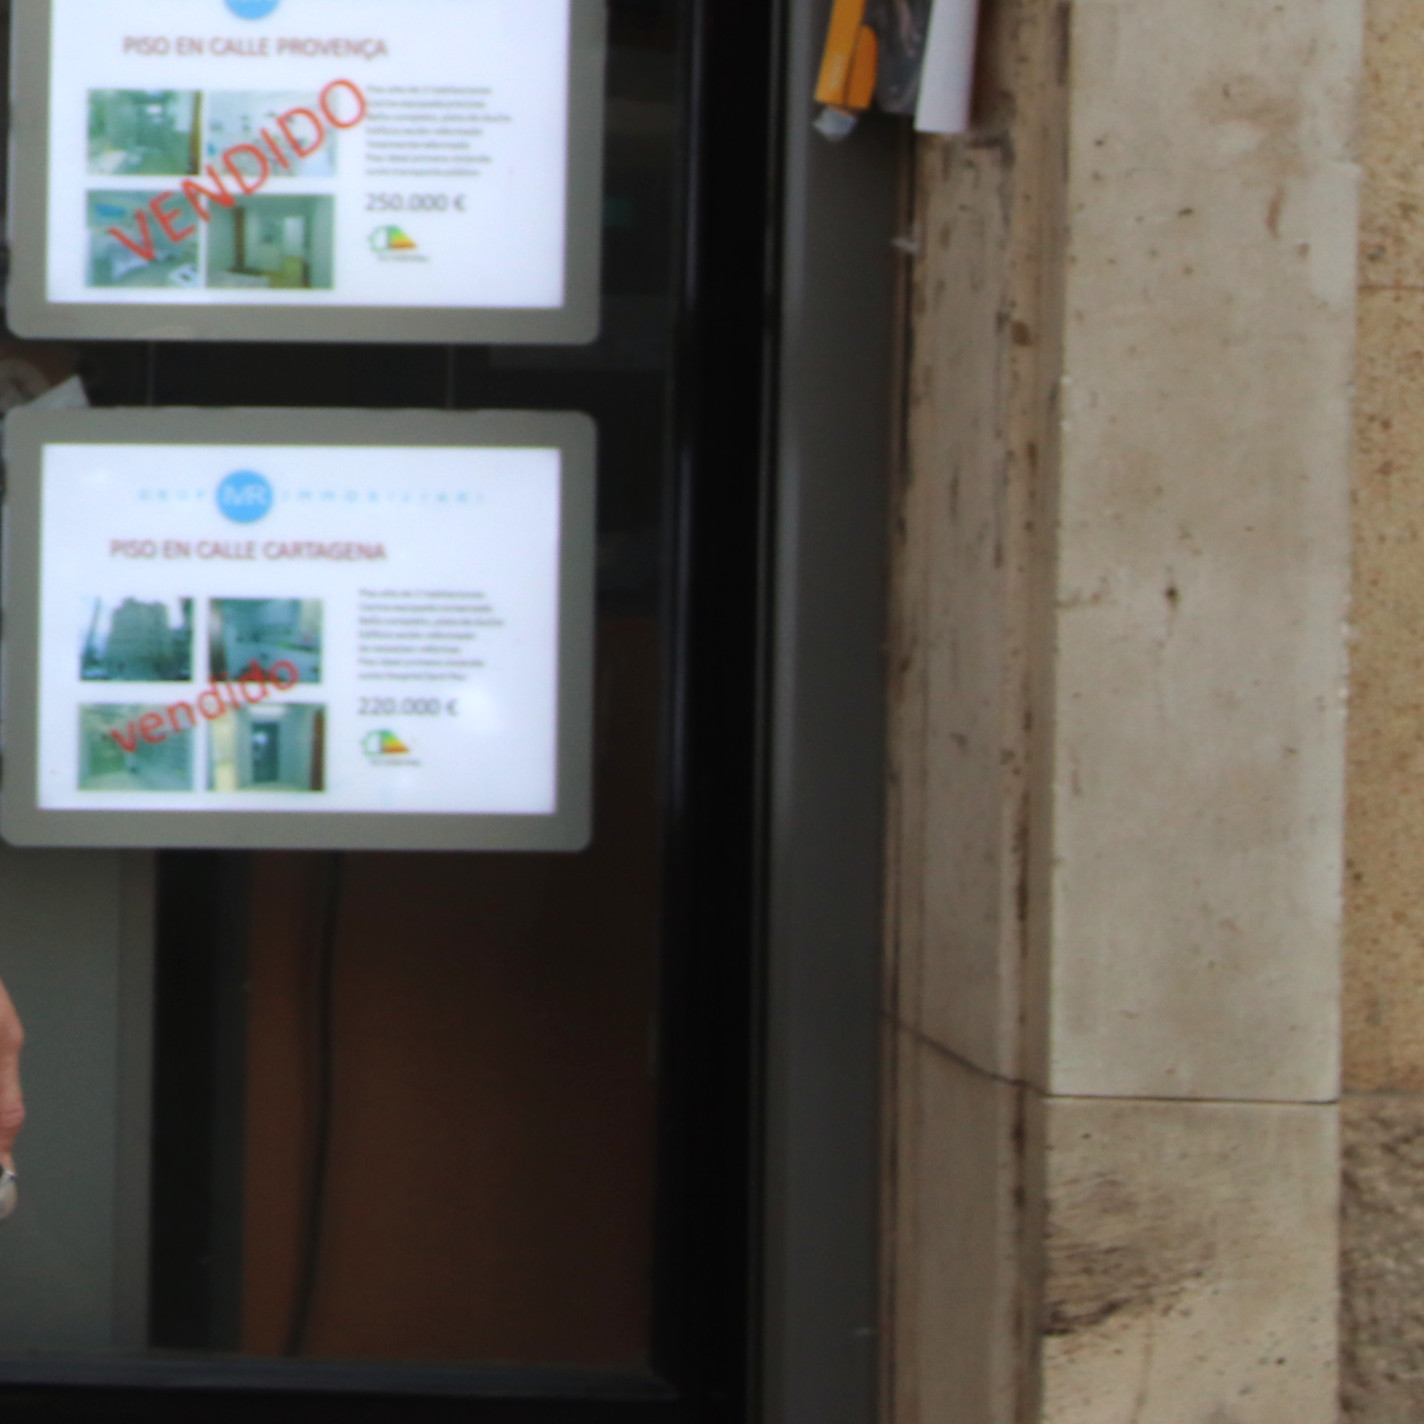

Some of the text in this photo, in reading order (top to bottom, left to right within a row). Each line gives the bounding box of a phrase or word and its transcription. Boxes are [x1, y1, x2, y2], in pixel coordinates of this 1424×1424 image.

[122, 36, 389, 61] PISO EN CALLE PROVENÇA
[108, 77, 368, 263] VENDIDO
[364, 192, 449, 213] 250.000
[109, 539, 388, 562] PISO EN CALLE CARTAGENA
[109, 656, 301, 755] vendido
[357, 696, 442, 717] 220.000
